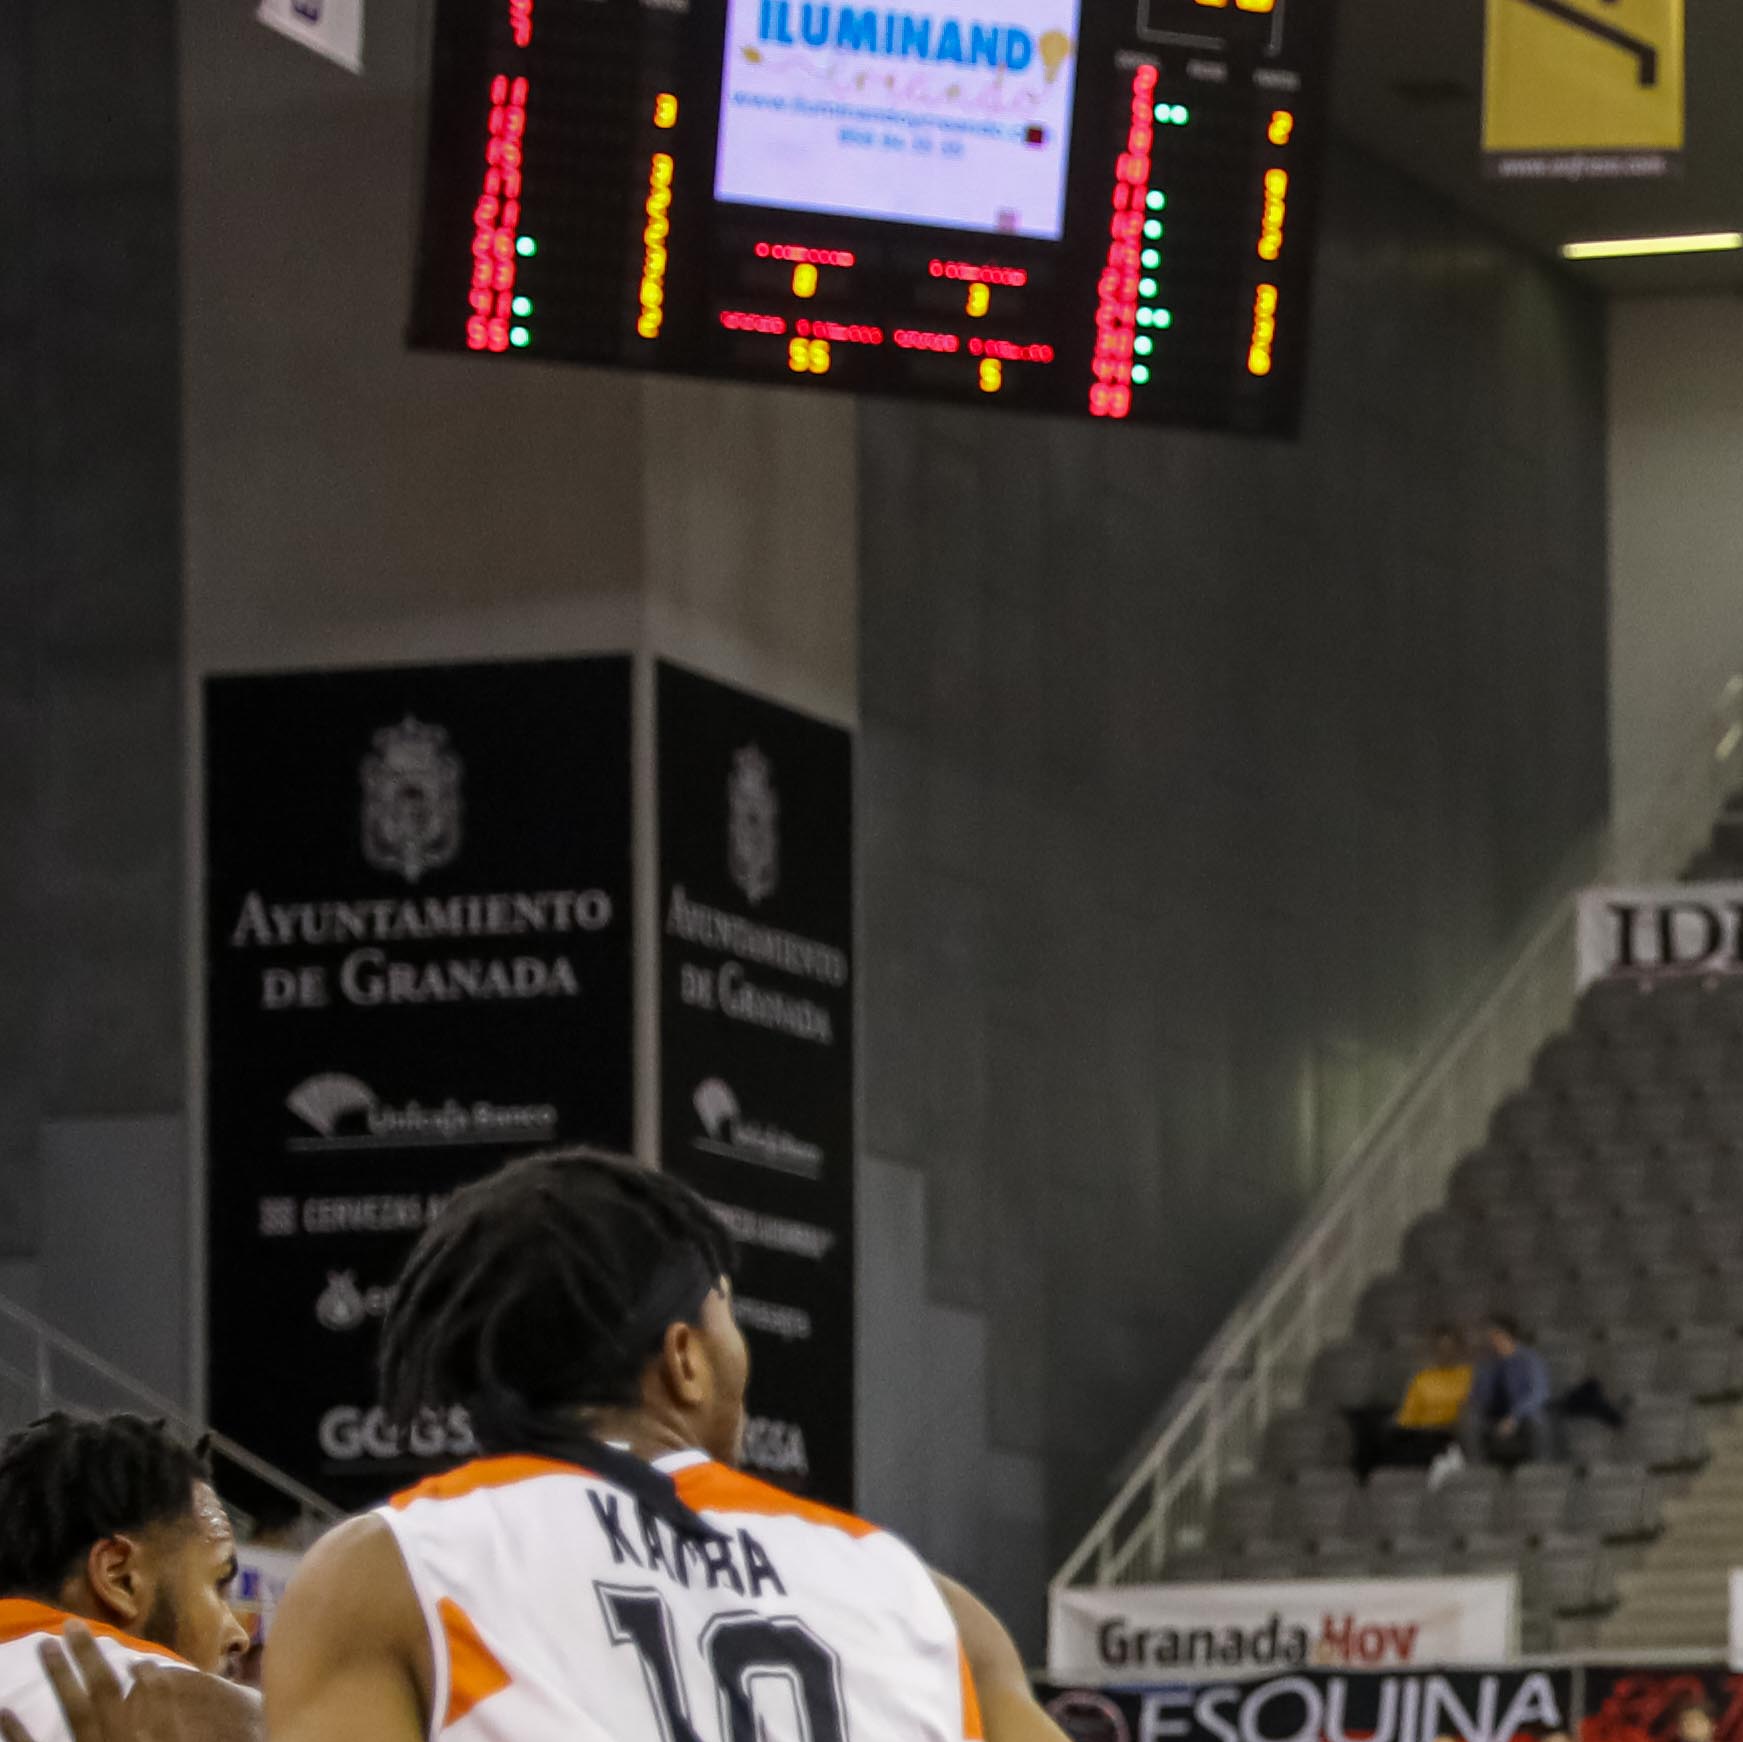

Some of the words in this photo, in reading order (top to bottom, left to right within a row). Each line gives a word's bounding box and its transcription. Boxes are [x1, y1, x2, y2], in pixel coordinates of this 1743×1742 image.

[232, 889, 612, 948] AYUNTAMIENTO
[261, 966, 326, 1008] DE
[340, 947, 579, 1007] GRANADA
[1099, 1611, 1308, 1669] Granada
